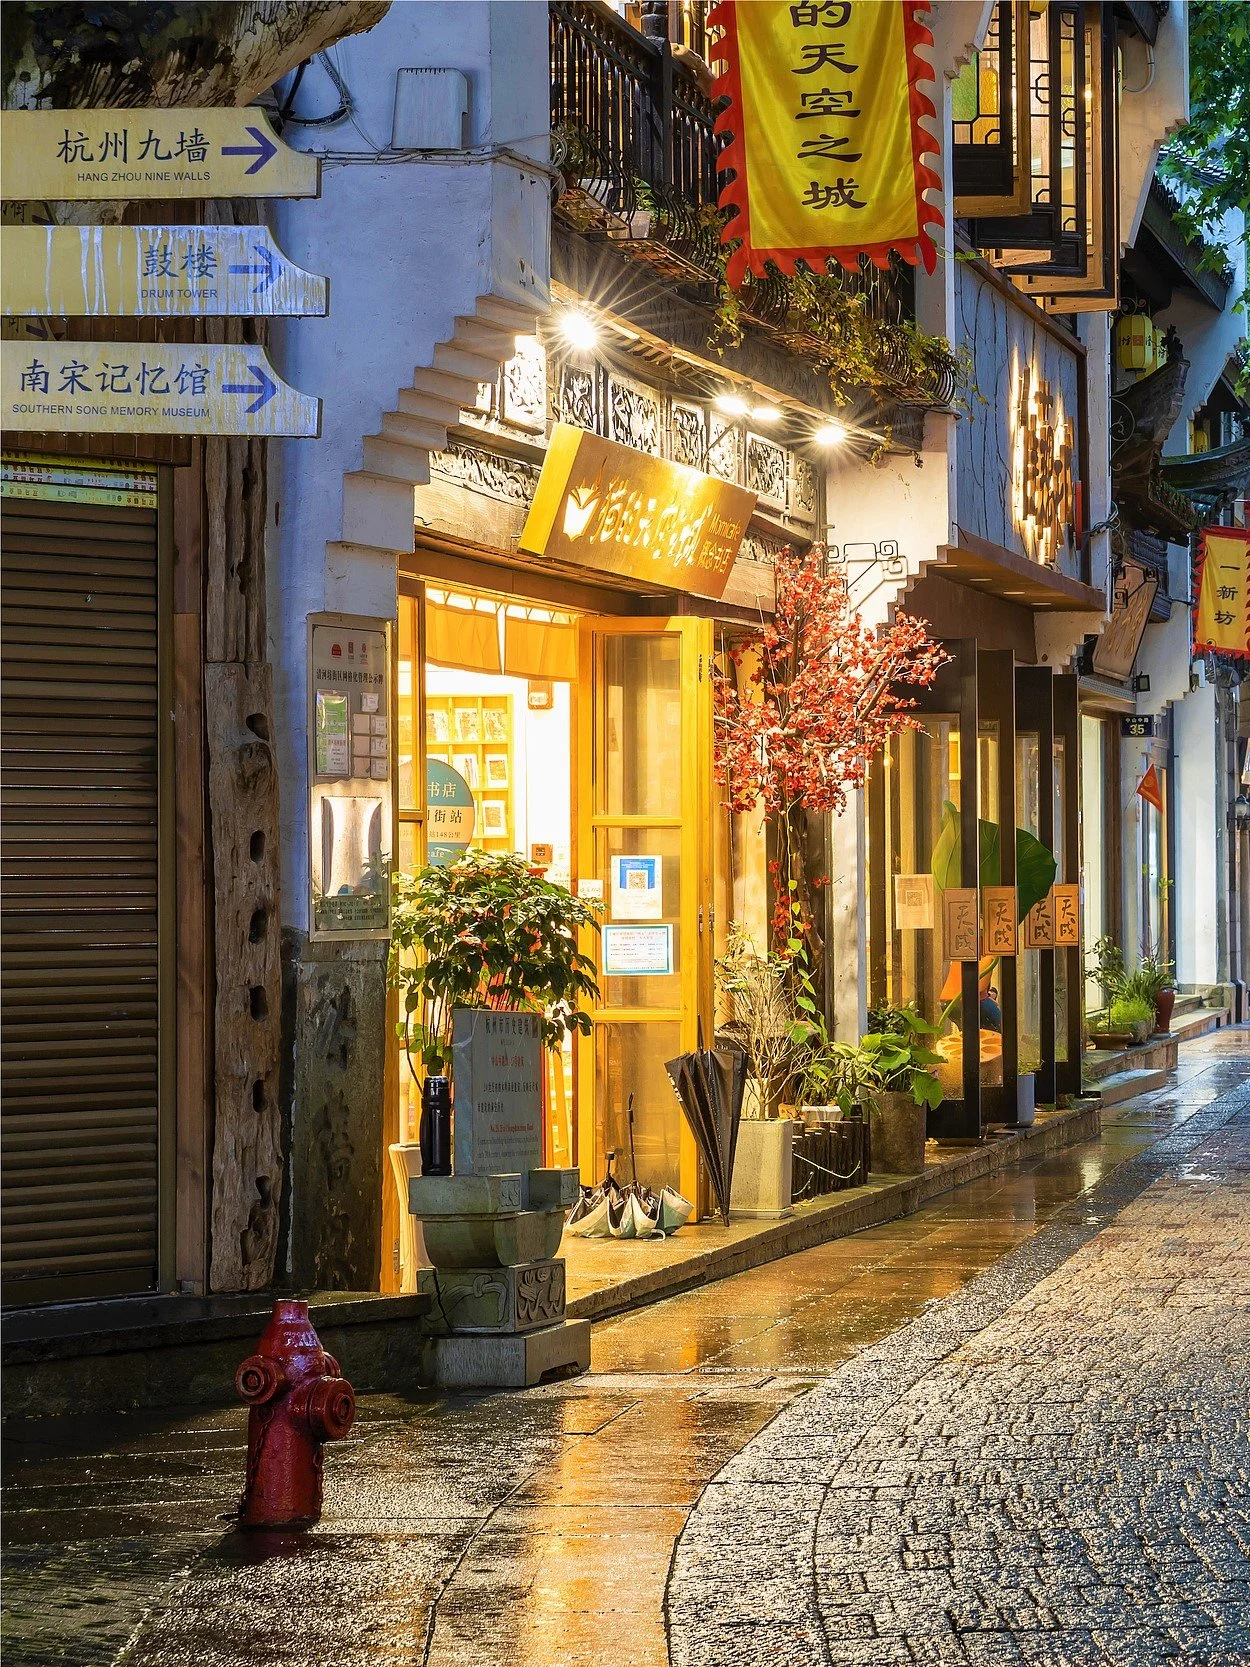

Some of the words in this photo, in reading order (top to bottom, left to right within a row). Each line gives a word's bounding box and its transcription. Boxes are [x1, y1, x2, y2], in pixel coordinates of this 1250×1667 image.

[789, 1, 867, 209] 的天空之城
[55, 128, 210, 164] 杭州九墙
[77, 172, 109, 182] HANG
[111, 172, 142, 182] ZHOU
[144, 172, 171, 182] NINE
[173, 171, 211, 181] WALLS
[142, 244, 218, 279] 鼓楼
[141, 289, 174, 299] DRUM
[177, 289, 218, 299] TOWER
[19, 359, 211, 396] 南宋记忆馆
[12, 404, 73, 414] SOUTHERN
[75, 405, 109, 415] SONG
[110, 406, 159, 416] MEMORY
[161, 407, 210, 418] MUSEUM
[1213, 565, 1241, 625] 一新坊
[1130, 724, 1145, 735] 35
[427, 809, 462, 823] 街站
